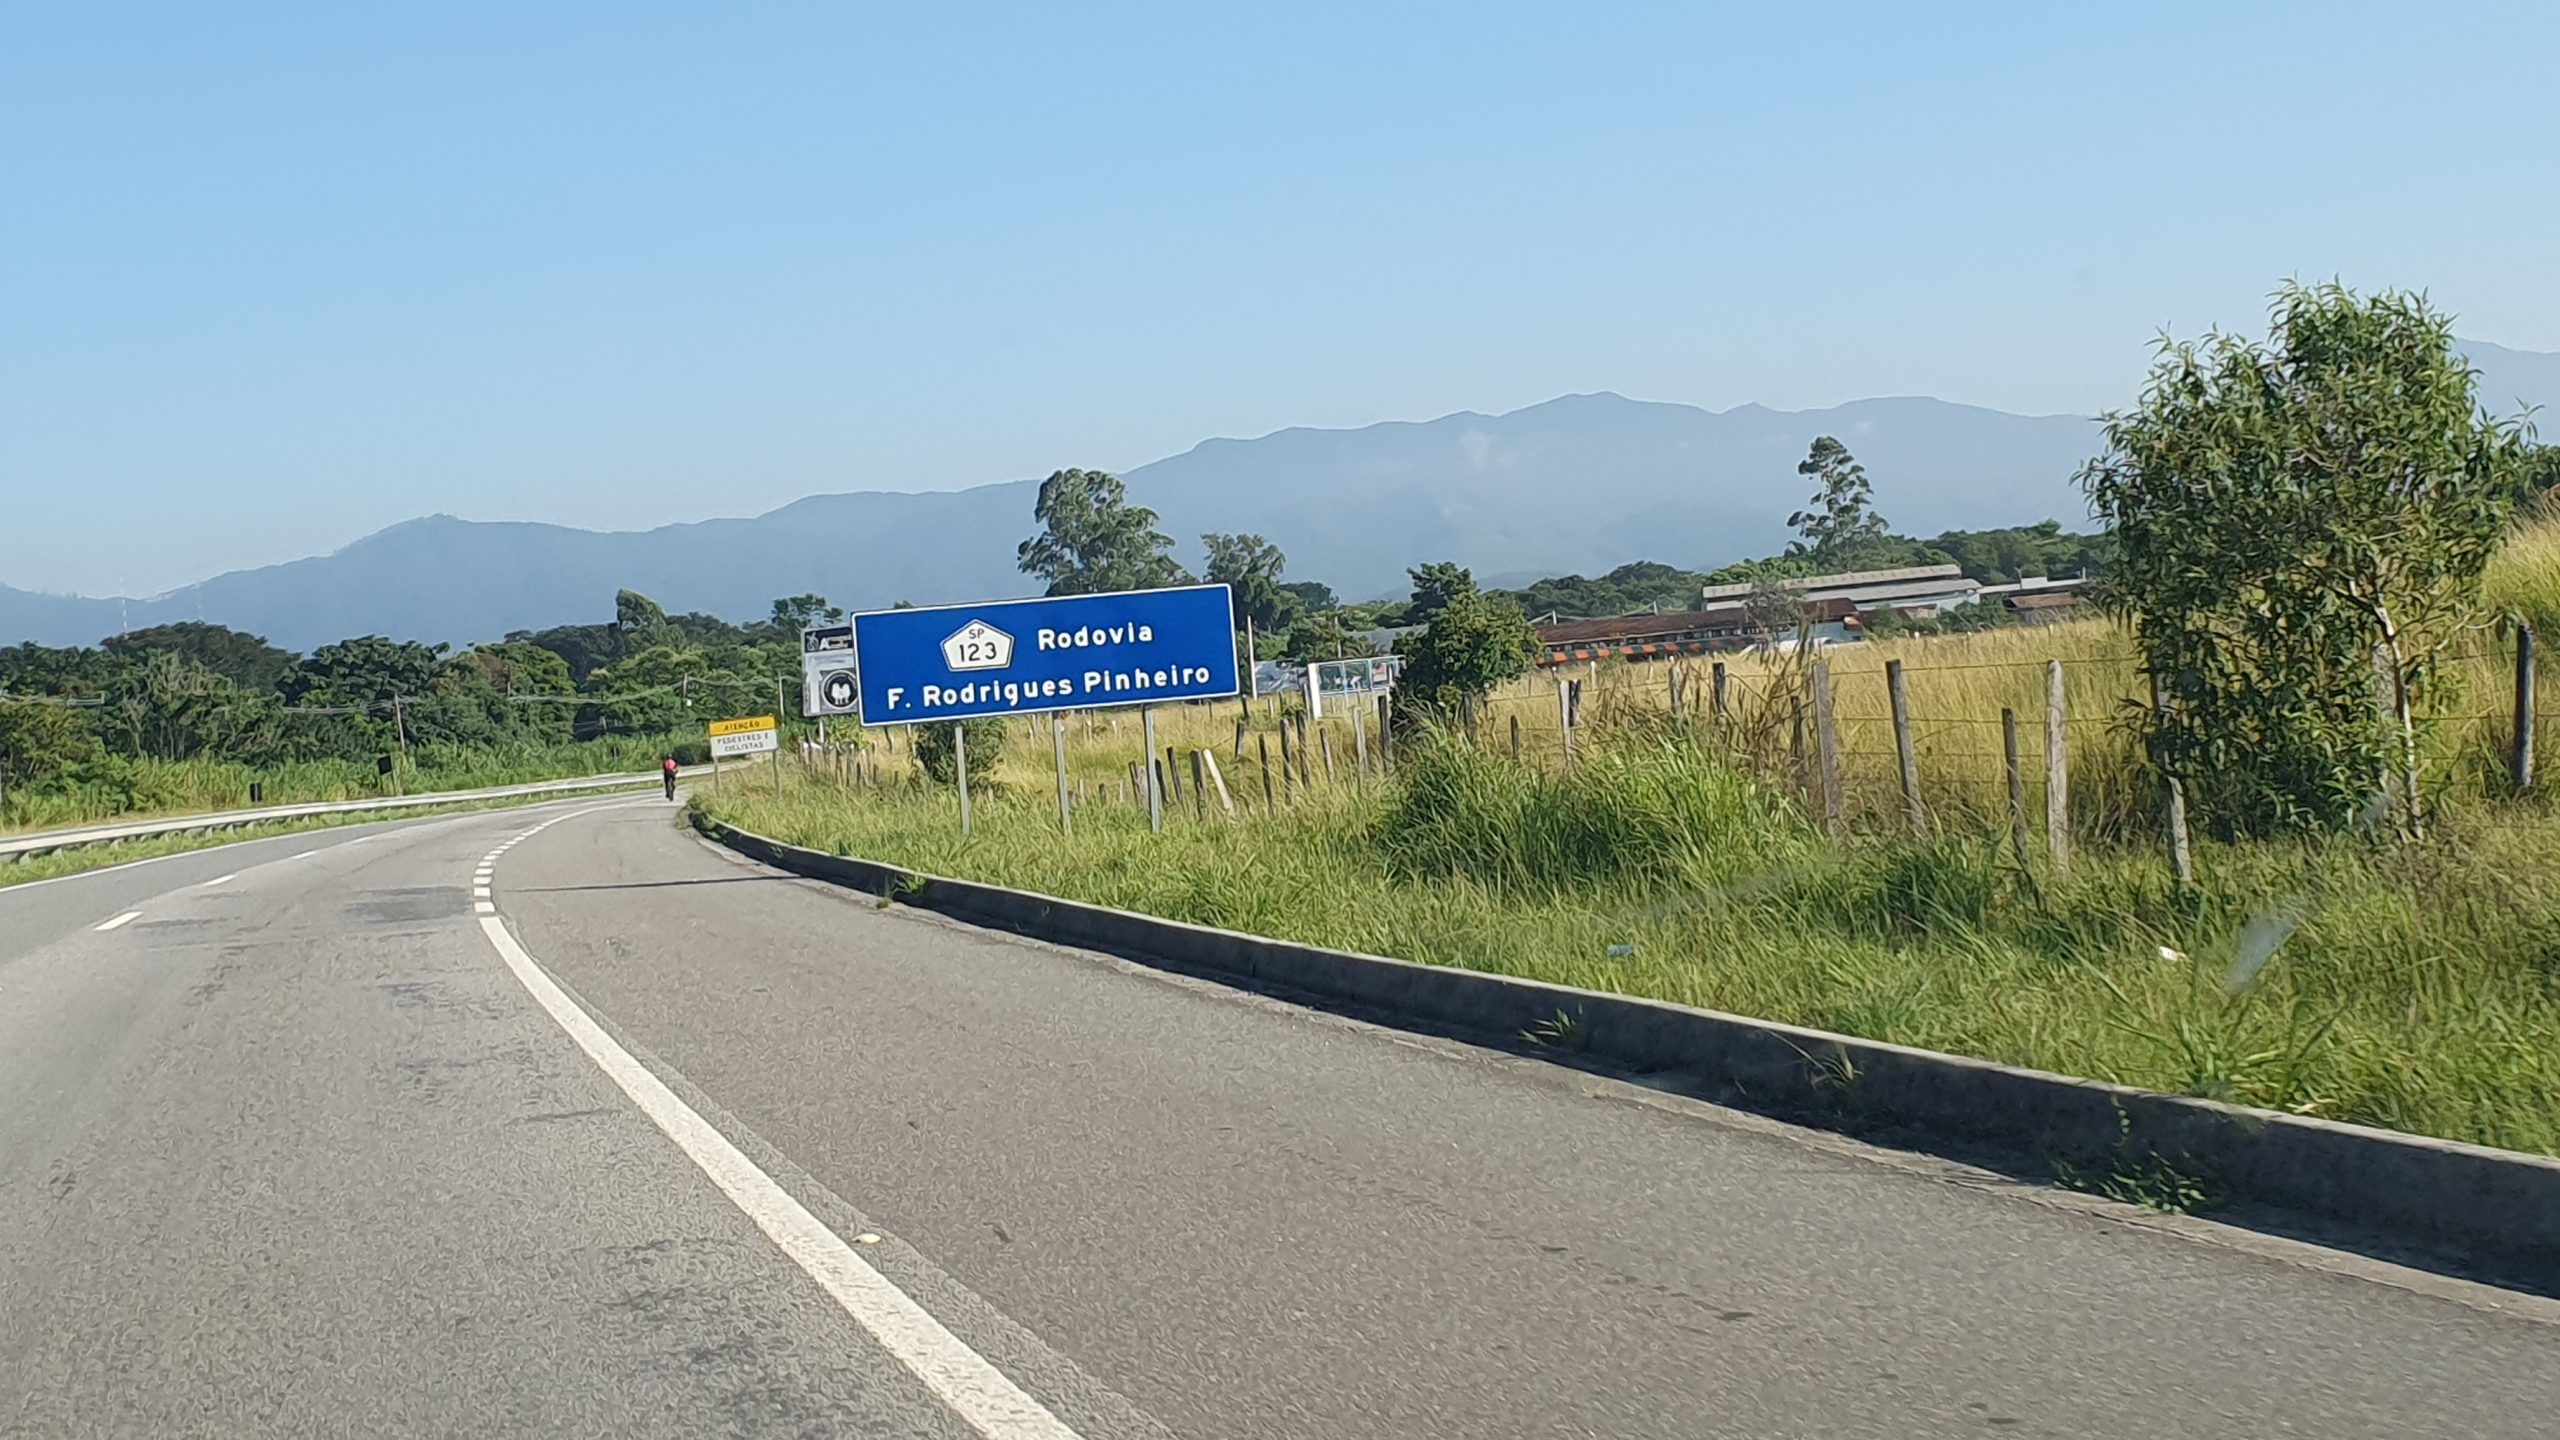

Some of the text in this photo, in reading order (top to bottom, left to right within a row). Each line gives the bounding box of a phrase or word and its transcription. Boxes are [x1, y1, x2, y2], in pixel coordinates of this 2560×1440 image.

[968, 628, 985, 640] SP
[1037, 621, 1153, 651] Rodovia
[958, 641, 998, 663] 123
[887, 664, 1211, 711] F. Rodrigues Pinheiro
